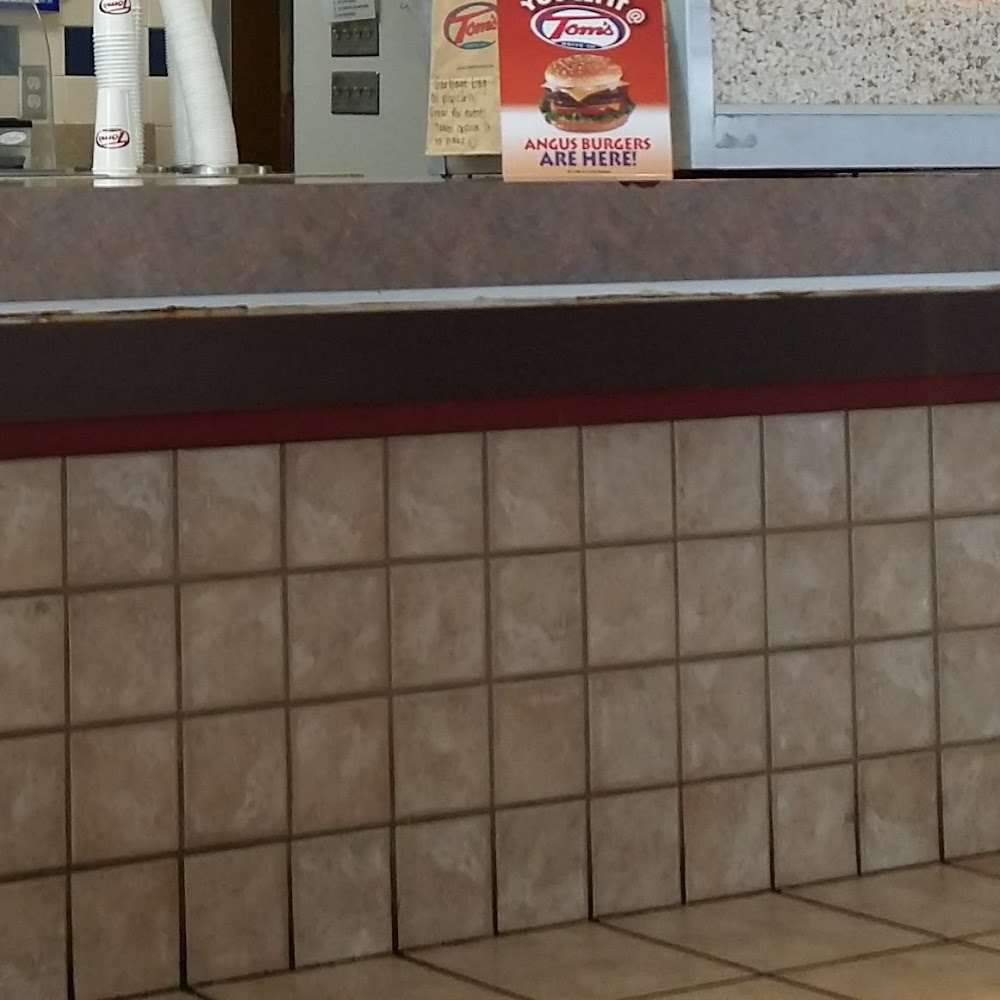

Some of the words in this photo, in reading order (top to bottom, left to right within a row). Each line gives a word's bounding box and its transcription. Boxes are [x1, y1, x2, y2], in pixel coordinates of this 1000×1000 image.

[543, 16, 614, 40] Tom's
[524, 138, 578, 150] ANGUS
[582, 137, 651, 150] BURGERS
[539, 151, 577, 167] ARE
[583, 151, 637, 167] HERE!
